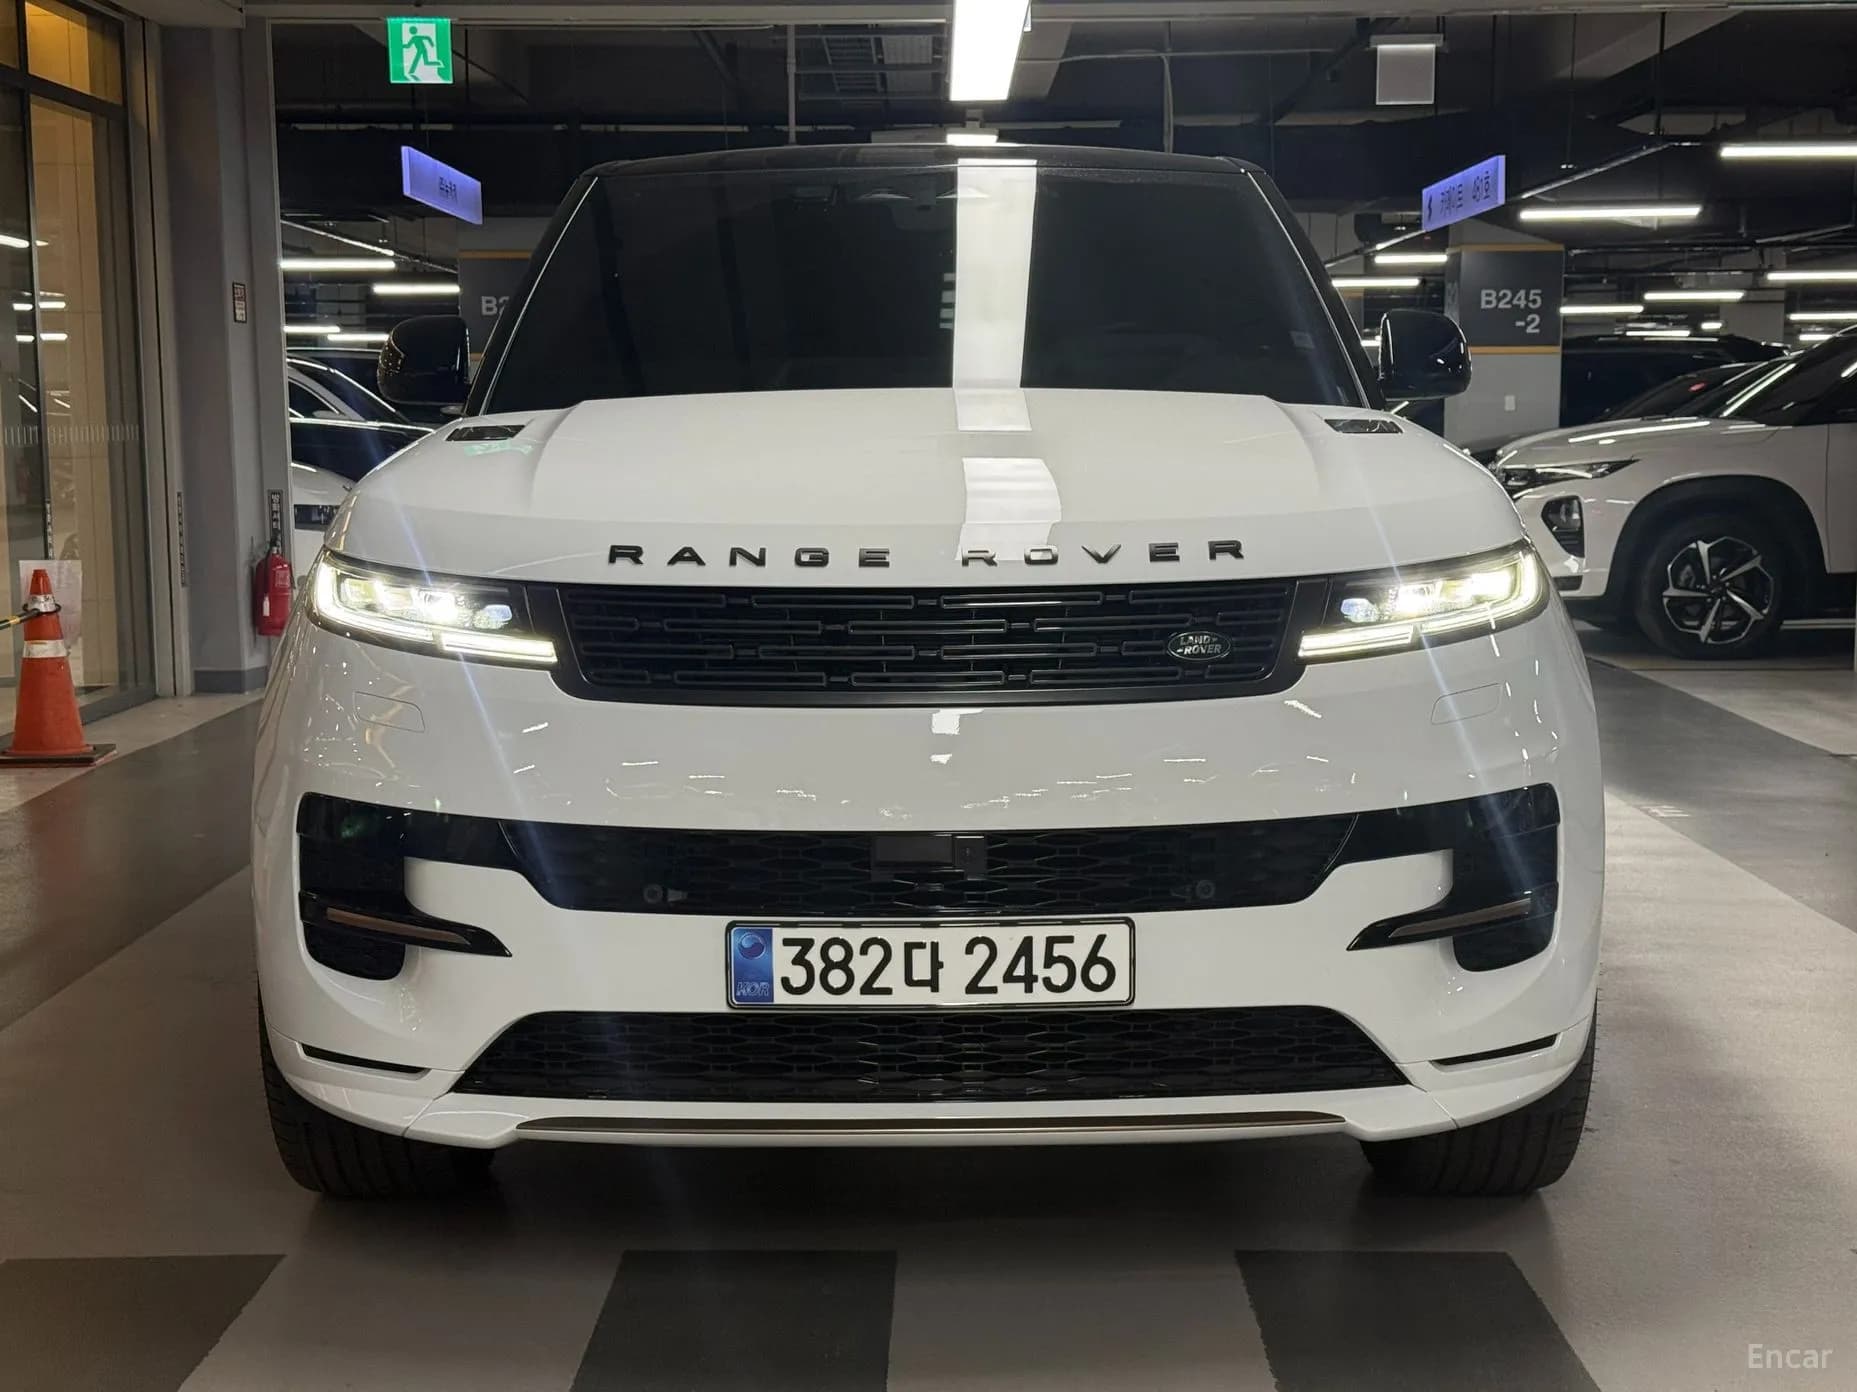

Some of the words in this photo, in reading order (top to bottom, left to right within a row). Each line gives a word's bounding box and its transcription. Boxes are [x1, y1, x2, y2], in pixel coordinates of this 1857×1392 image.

[1480, 289, 1542, 309] B245
[1515, 313, 1541, 334] -2
[608, 544, 890, 568] RANGE
[961, 539, 1245, 567] ROVER
[781, 936, 944, 996] 382다
[964, 933, 1117, 995] 2456
[736, 981, 769, 997] KOR
